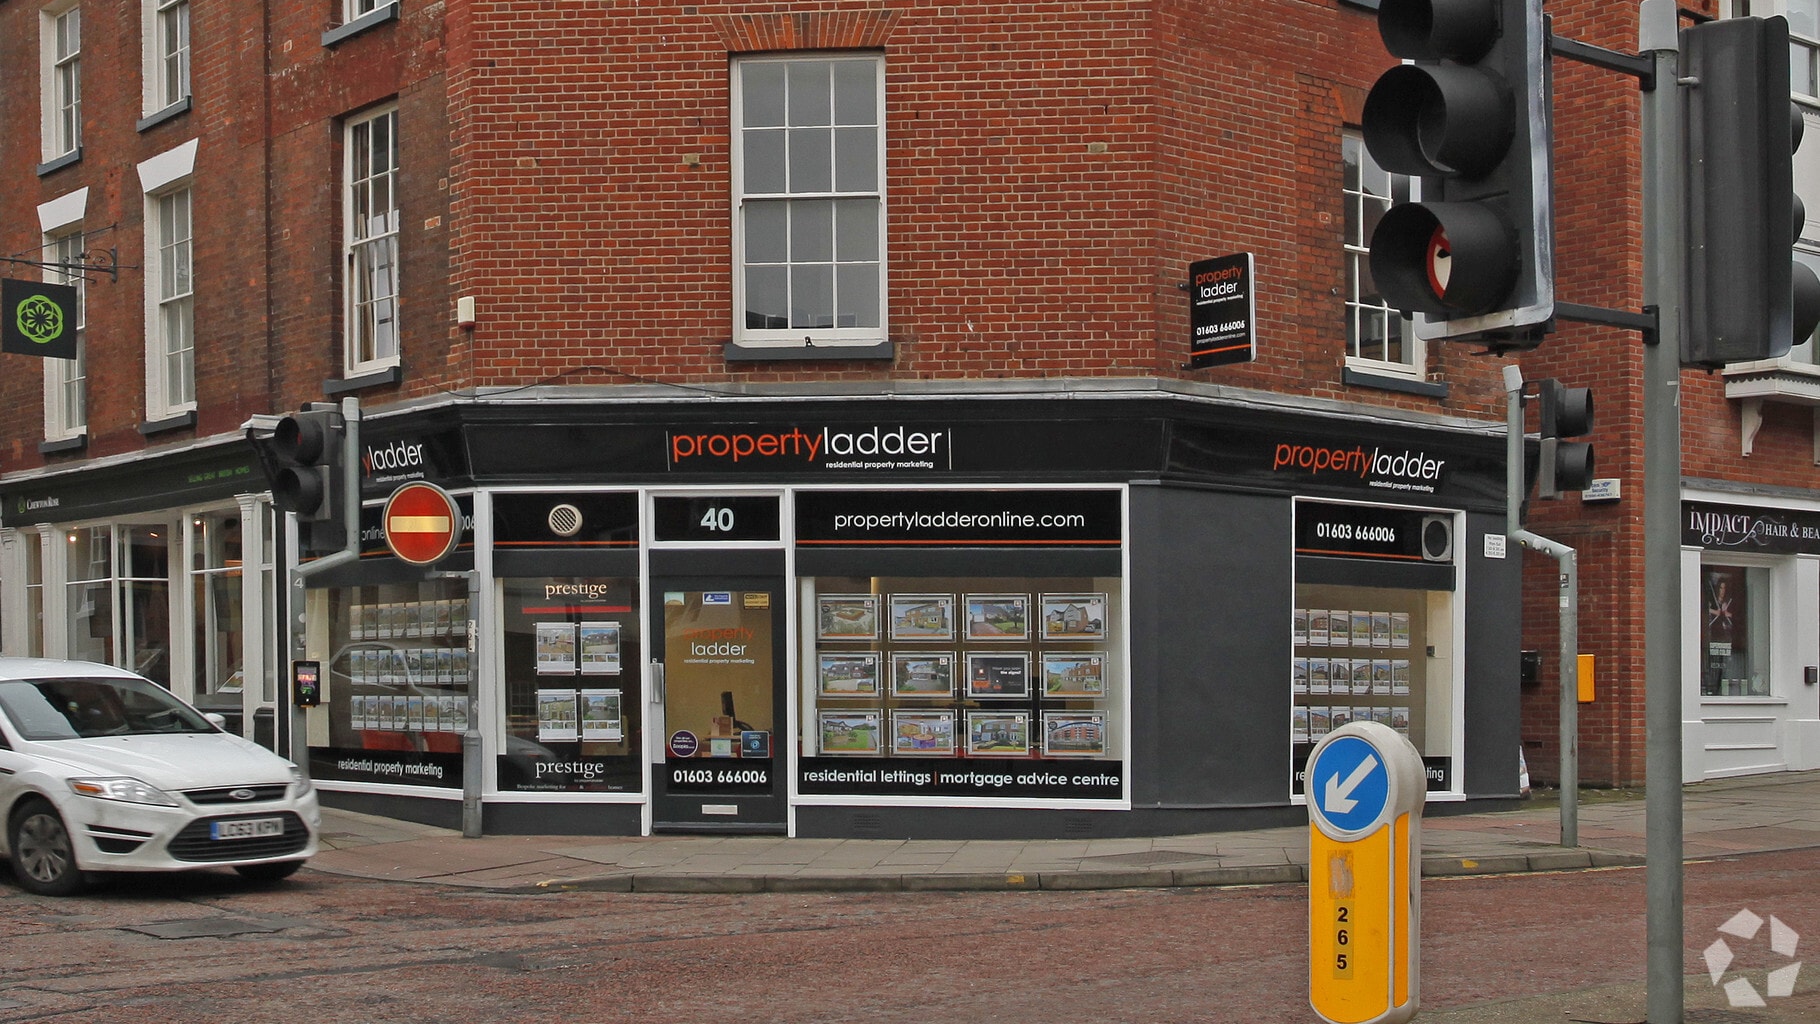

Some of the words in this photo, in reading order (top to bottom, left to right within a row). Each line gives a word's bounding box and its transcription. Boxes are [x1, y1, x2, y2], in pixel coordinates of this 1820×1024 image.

[1196, 266, 1242, 286] property
[1200, 282, 1238, 298] ladder
[1196, 324, 1218, 336] 01603
[1220, 320, 1245, 332] 666006
[673, 426, 942, 463] propertyladder
[864, 462, 895, 470] property
[896, 461, 934, 469] marketing
[1273, 443, 1445, 480] propertyladder
[1369, 480, 1393, 489] residential
[1393, 482, 1412, 491] property
[1412, 484, 1434, 493] marketing
[700, 508, 734, 531] 40
[834, 511, 1085, 531] propertyladderonline.com
[1317, 523, 1351, 539] 01603
[1355, 526, 1395, 542] 666006
[1765, 523, 1787, 537] HAIR
[1790, 522, 1799, 538] &
[545, 583, 607, 600] prestige
[683, 627, 754, 641] property
[691, 641, 747, 656] ladder
[338, 759, 373, 772] residential
[374, 761, 404, 776] property
[405, 762, 443, 778] marketing
[535, 761, 604, 778] prestige
[673, 770, 713, 783] 01603
[717, 770, 767, 783] 666006
[804, 770, 877, 783] residential
[880, 770, 931, 784] lettings
[940, 772, 1013, 787] mortgage
[1017, 772, 1068, 785] advice
[1072, 774, 1120, 786] centre
